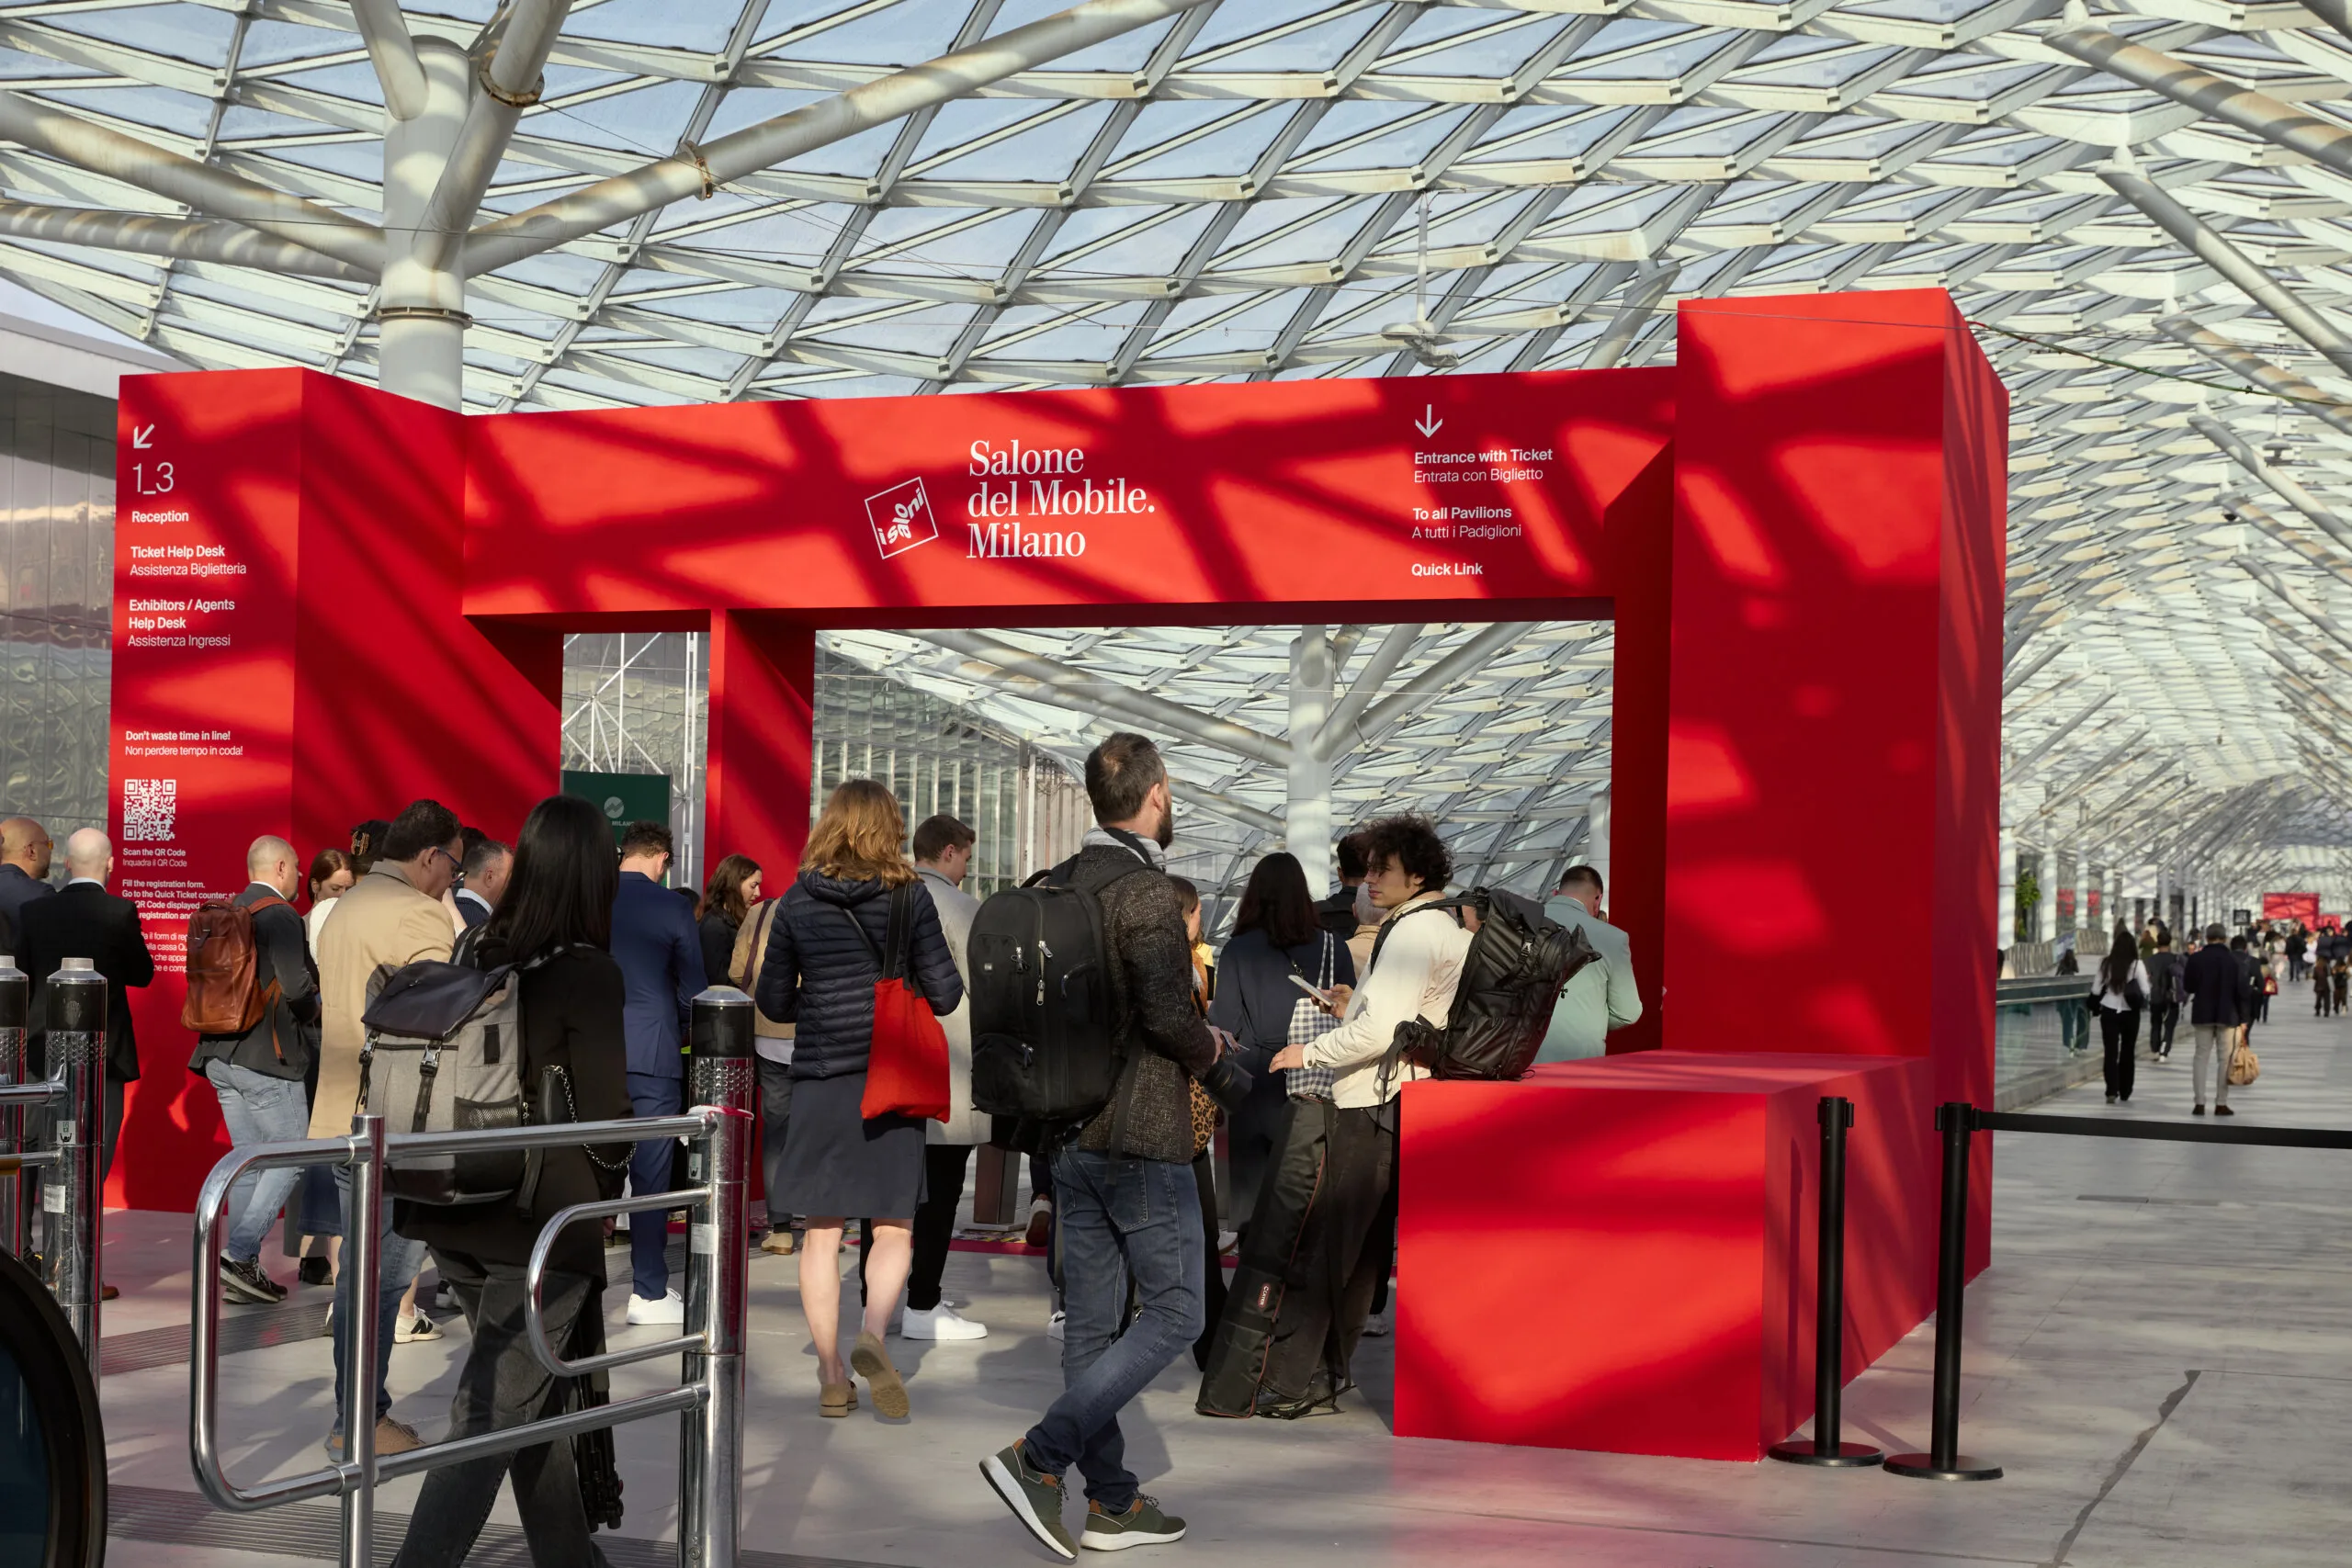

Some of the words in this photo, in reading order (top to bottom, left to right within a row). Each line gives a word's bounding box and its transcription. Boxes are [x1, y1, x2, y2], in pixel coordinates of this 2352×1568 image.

[969, 439, 1084, 477] Salone
[1415, 452, 1476, 464] Entrance
[1479, 450, 1507, 462] with
[1510, 448, 1553, 461] Ticket
[1414, 470, 1459, 483] Entrata
[1463, 471, 1487, 481] con
[1491, 468, 1543, 483] Biglietto
[968, 480, 1019, 517] del
[1028, 478, 1156, 516] Mobile.
[132, 511, 189, 525] Reception
[1413, 508, 1429, 520] To
[1431, 507, 1447, 520] all
[1452, 507, 1511, 519] Pavilions
[1412, 526, 1421, 538] A
[1425, 526, 1449, 538] tutti
[1460, 525, 1521, 539] Padiglioni
[967, 523, 1086, 558] Milano
[130, 546, 164, 558] Ticket
[167, 546, 194, 558] Help
[197, 545, 225, 558] Desk
[130, 563, 187, 575] Assistenza
[191, 562, 246, 578] Biglietteria
[1411, 563, 1451, 576] Quick
[1454, 563, 1483, 575] Link
[130, 600, 185, 611] Exhibitors
[187, 600, 192, 610] /
[195, 599, 235, 613] Agents
[129, 617, 155, 631] Help
[158, 616, 186, 629] Desk
[128, 635, 186, 647] Assistenza
[188, 634, 231, 649] Ingressi
[152, 731, 177, 741] waste
[179, 731, 200, 740] time
[201, 731, 209, 740] in
[212, 730, 231, 740] line!
[125, 746, 143, 755] Non
[145, 746, 177, 757] perdere
[180, 747, 208, 757] tempo
[209, 746, 217, 755] in
[220, 746, 243, 756] coda!
[123, 848, 141, 856] Scan
[123, 859, 151, 867] Inquadra
[169, 859, 187, 867] Code
[134, 879, 145, 887] the
[147, 880, 186, 888] registration
[154, 890, 175, 898] Quick
[167, 901, 199, 910] displayed
[139, 911, 178, 920] registration
